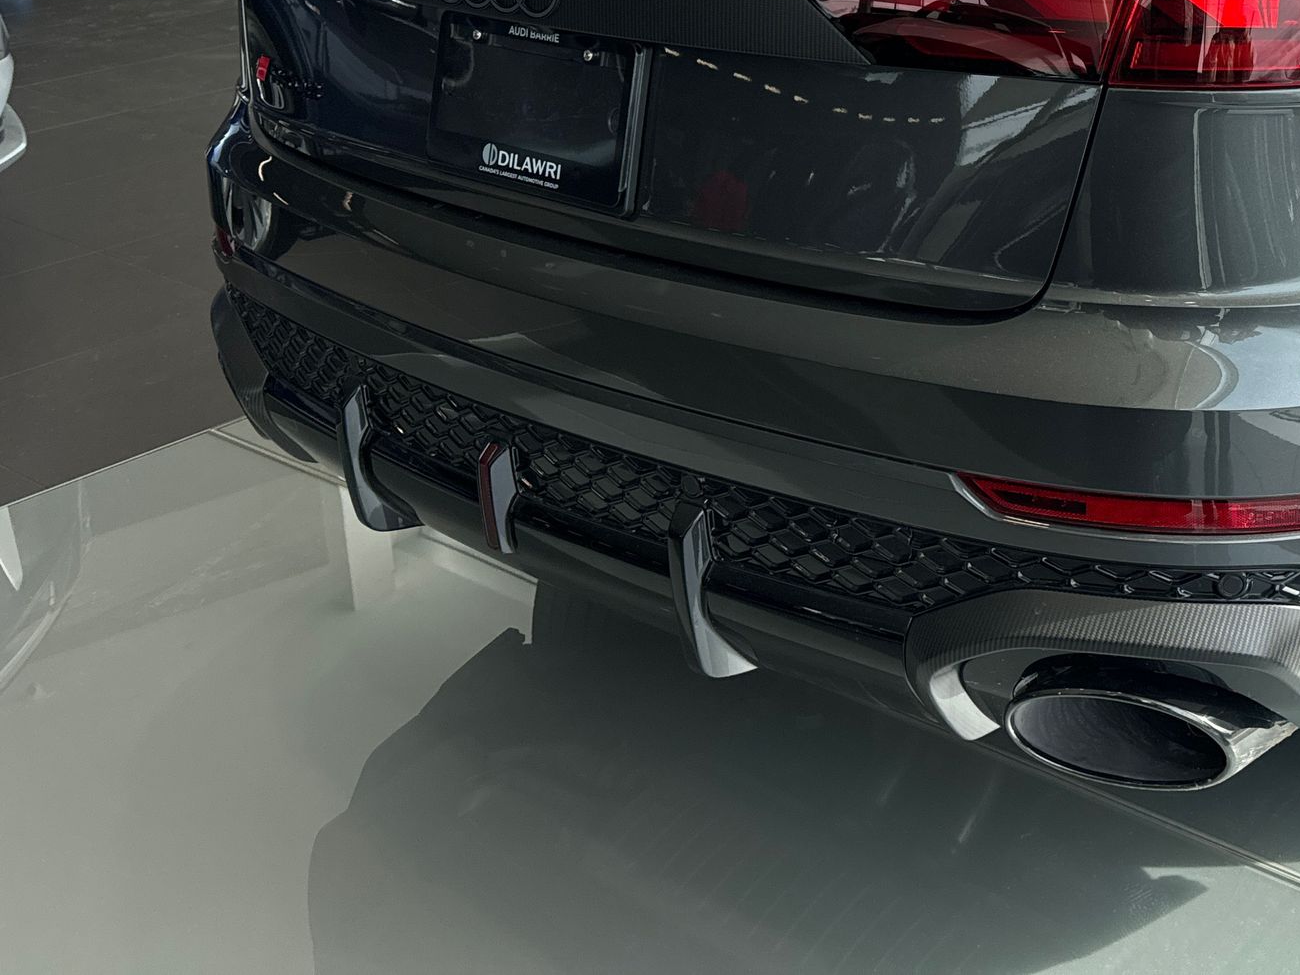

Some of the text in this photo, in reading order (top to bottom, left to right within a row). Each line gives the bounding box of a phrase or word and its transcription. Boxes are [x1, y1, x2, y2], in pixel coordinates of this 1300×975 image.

[508, 25, 560, 43] AUDI BARRIE
[478, 165, 559, 190] CANADA'S LARGEST AUTOMOTIVE GROUP
[497, 150, 562, 180] DILAWRI
